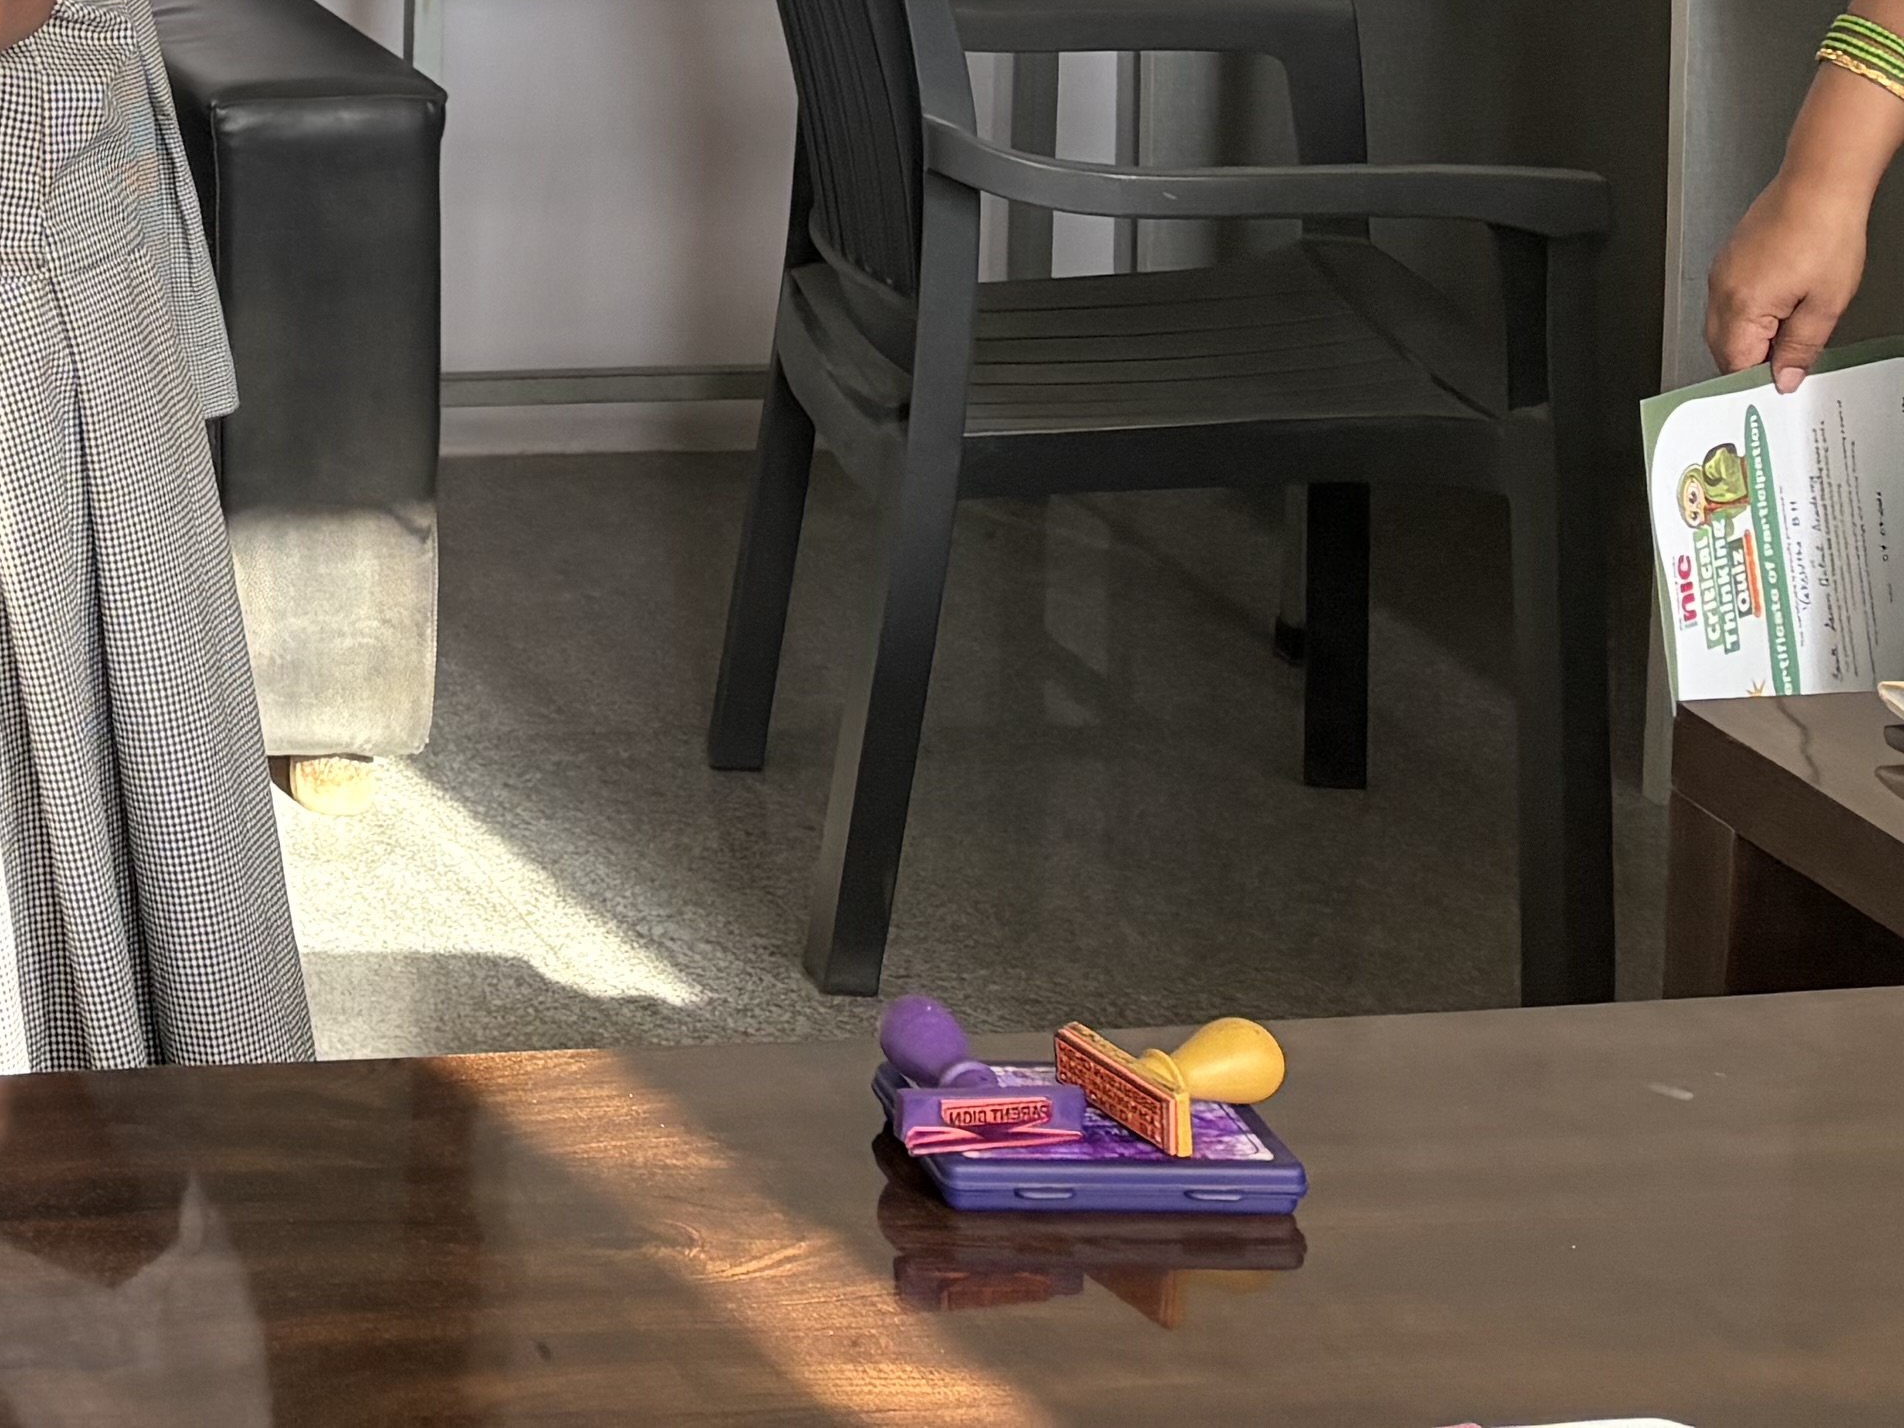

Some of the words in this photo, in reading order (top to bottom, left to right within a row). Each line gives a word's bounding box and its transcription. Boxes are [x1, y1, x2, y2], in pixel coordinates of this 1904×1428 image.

[1750, 414, 1774, 558] Participation
[1696, 534, 1721, 641] Critical
[1712, 518, 1738, 649] Thinking
[1732, 548, 1750, 612] Quiz
[1764, 561, 1777, 585] of
[1769, 589, 1793, 695] ertificate
